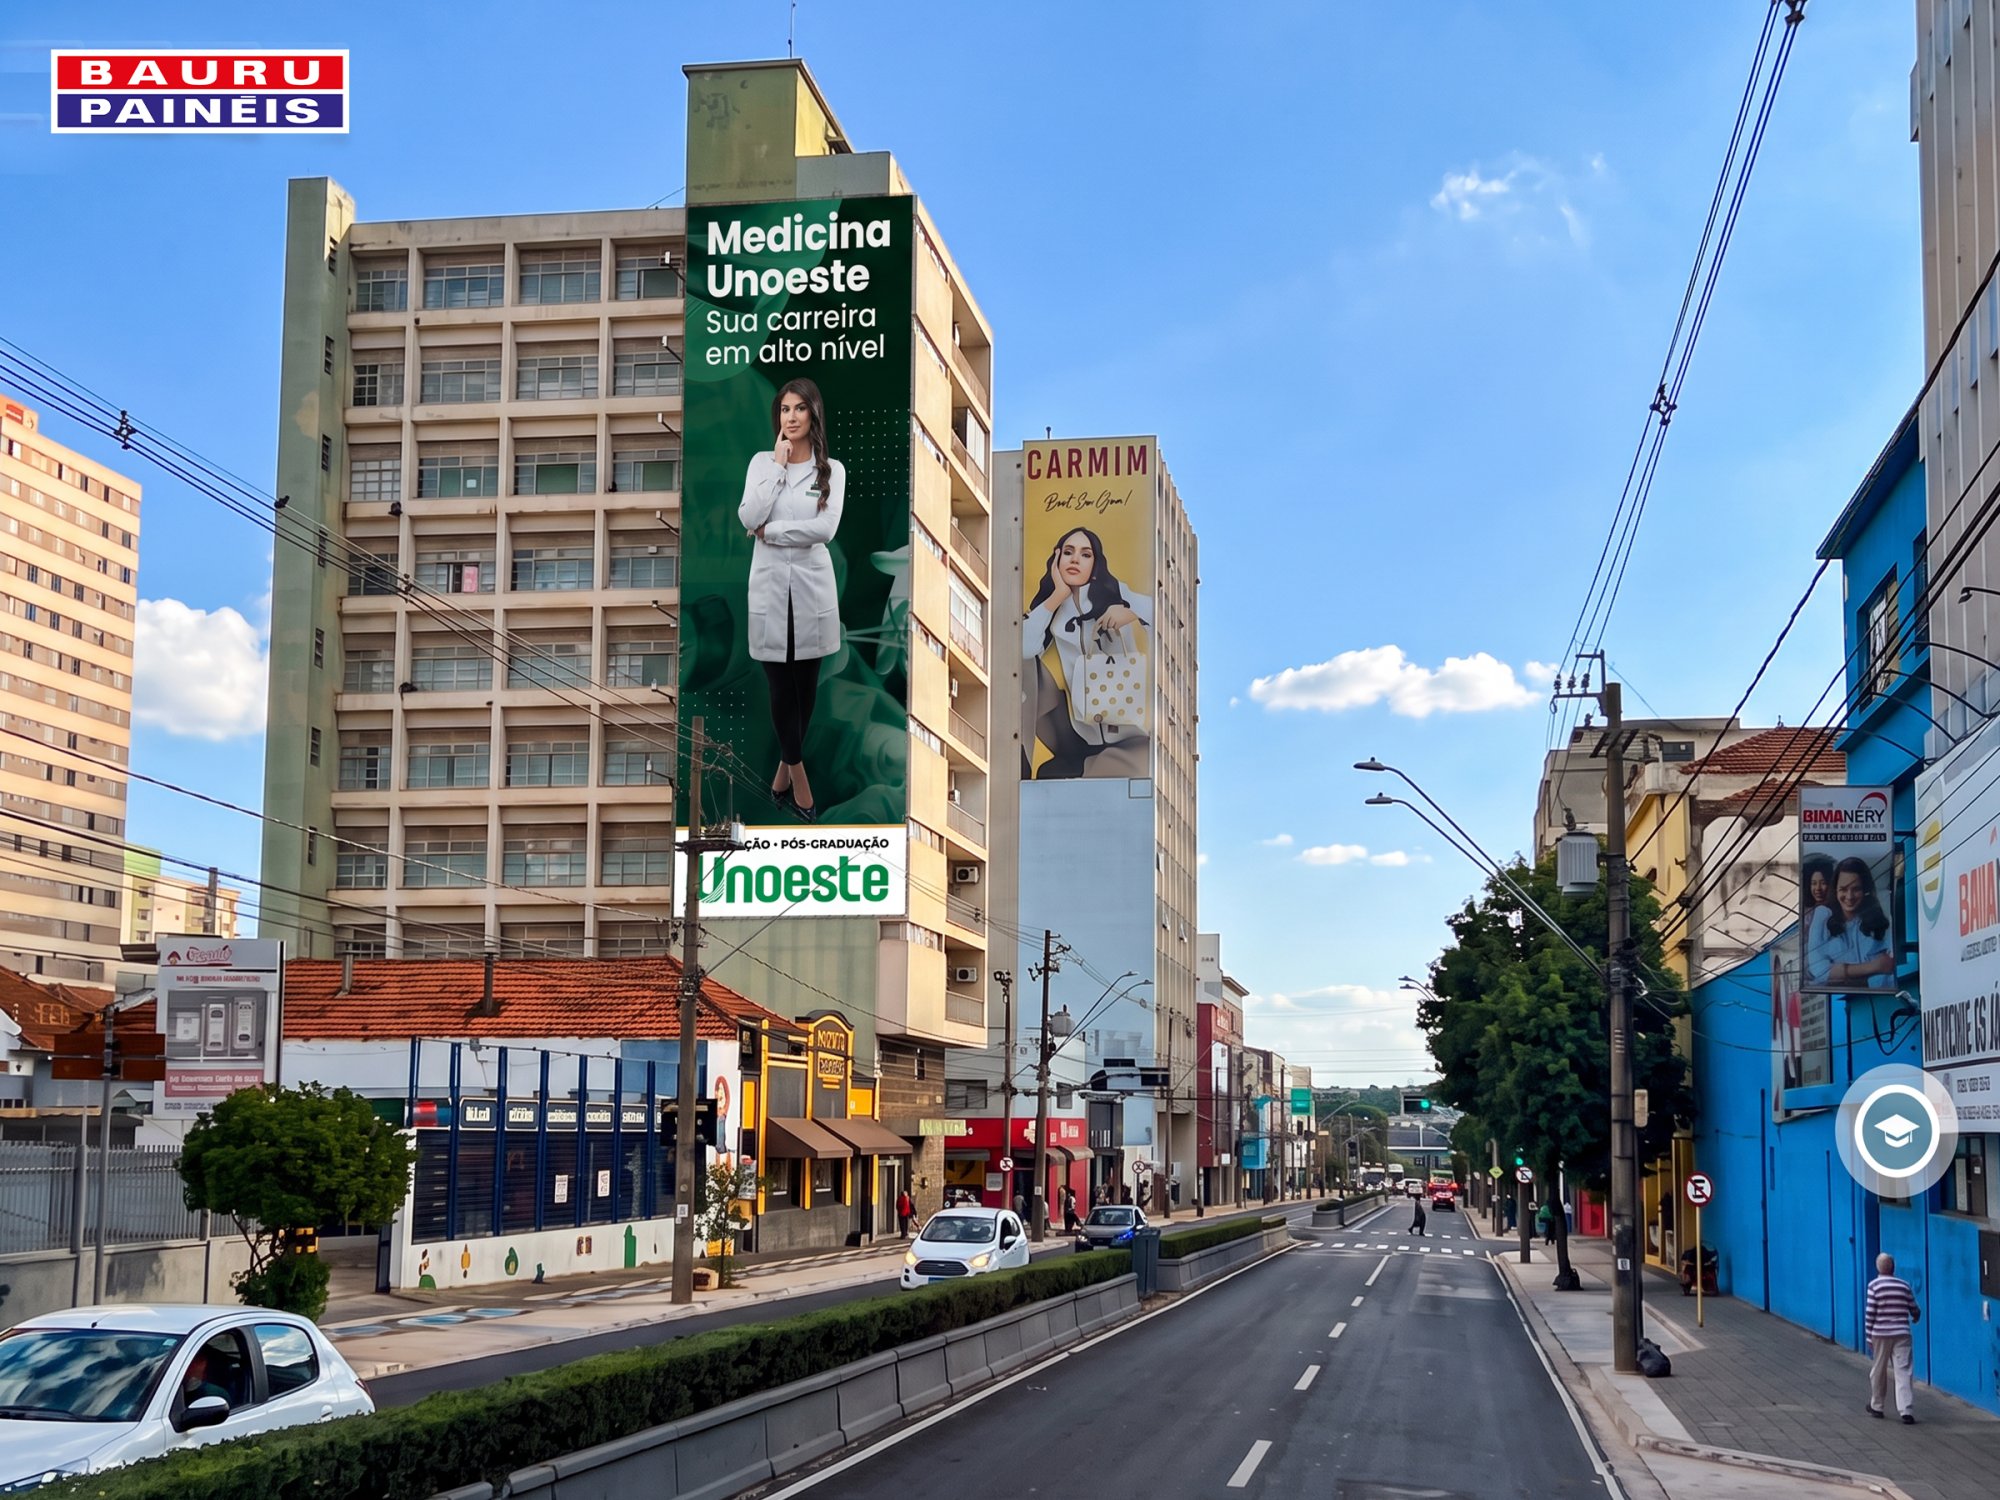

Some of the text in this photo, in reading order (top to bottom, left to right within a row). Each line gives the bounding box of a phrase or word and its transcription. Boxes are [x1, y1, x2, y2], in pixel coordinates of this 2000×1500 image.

[707, 211, 891, 255] Medicina
[707, 260, 870, 298] Unoeste
[706, 303, 876, 334] Sua carreira
[705, 334, 885, 365] em alto nível
[1027, 445, 1147, 480] CARMIM
[1803, 809, 1885, 823] BIMANERY
[781, 836, 890, 851] PÓS-GRADUAÇÃO
[698, 855, 890, 903] Unoeste
